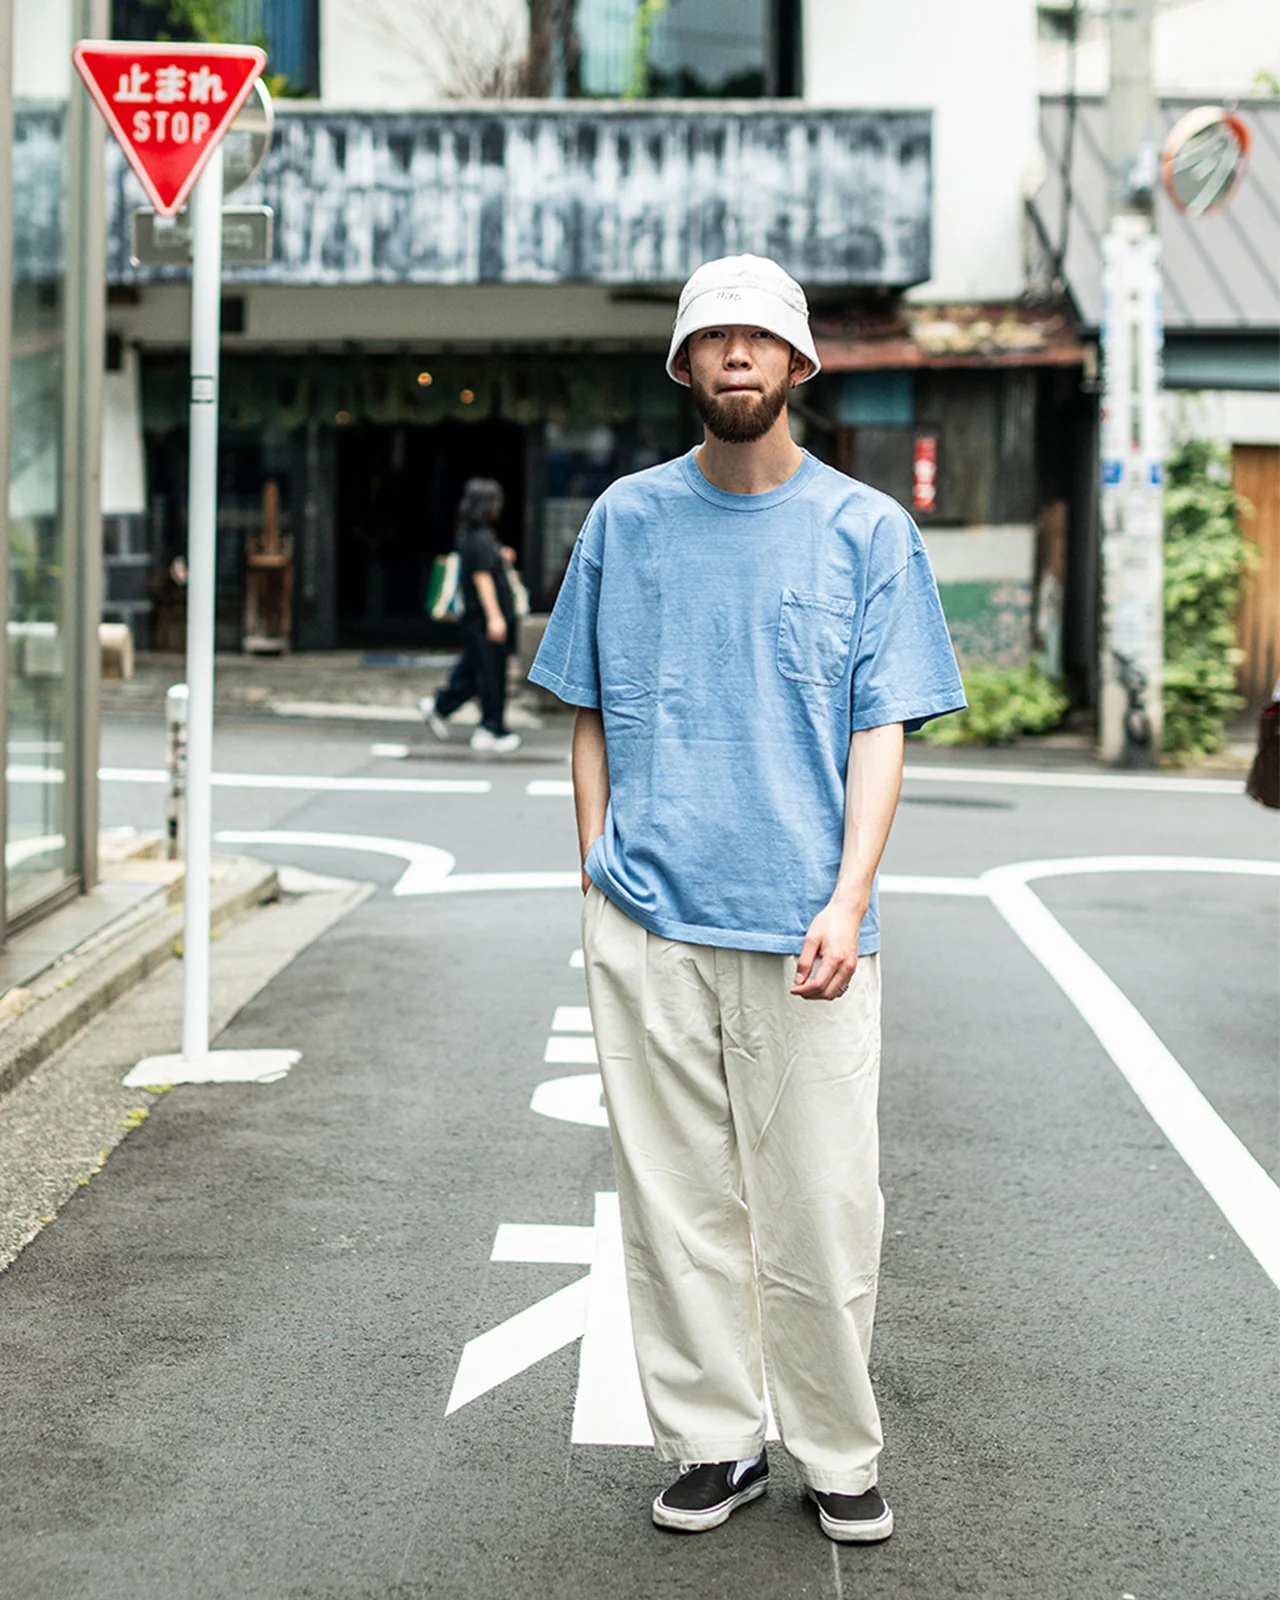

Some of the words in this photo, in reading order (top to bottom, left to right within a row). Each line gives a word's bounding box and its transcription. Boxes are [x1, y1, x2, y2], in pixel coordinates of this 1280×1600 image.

[113, 63, 228, 103] 止まれ
[132, 110, 211, 144] STOP
